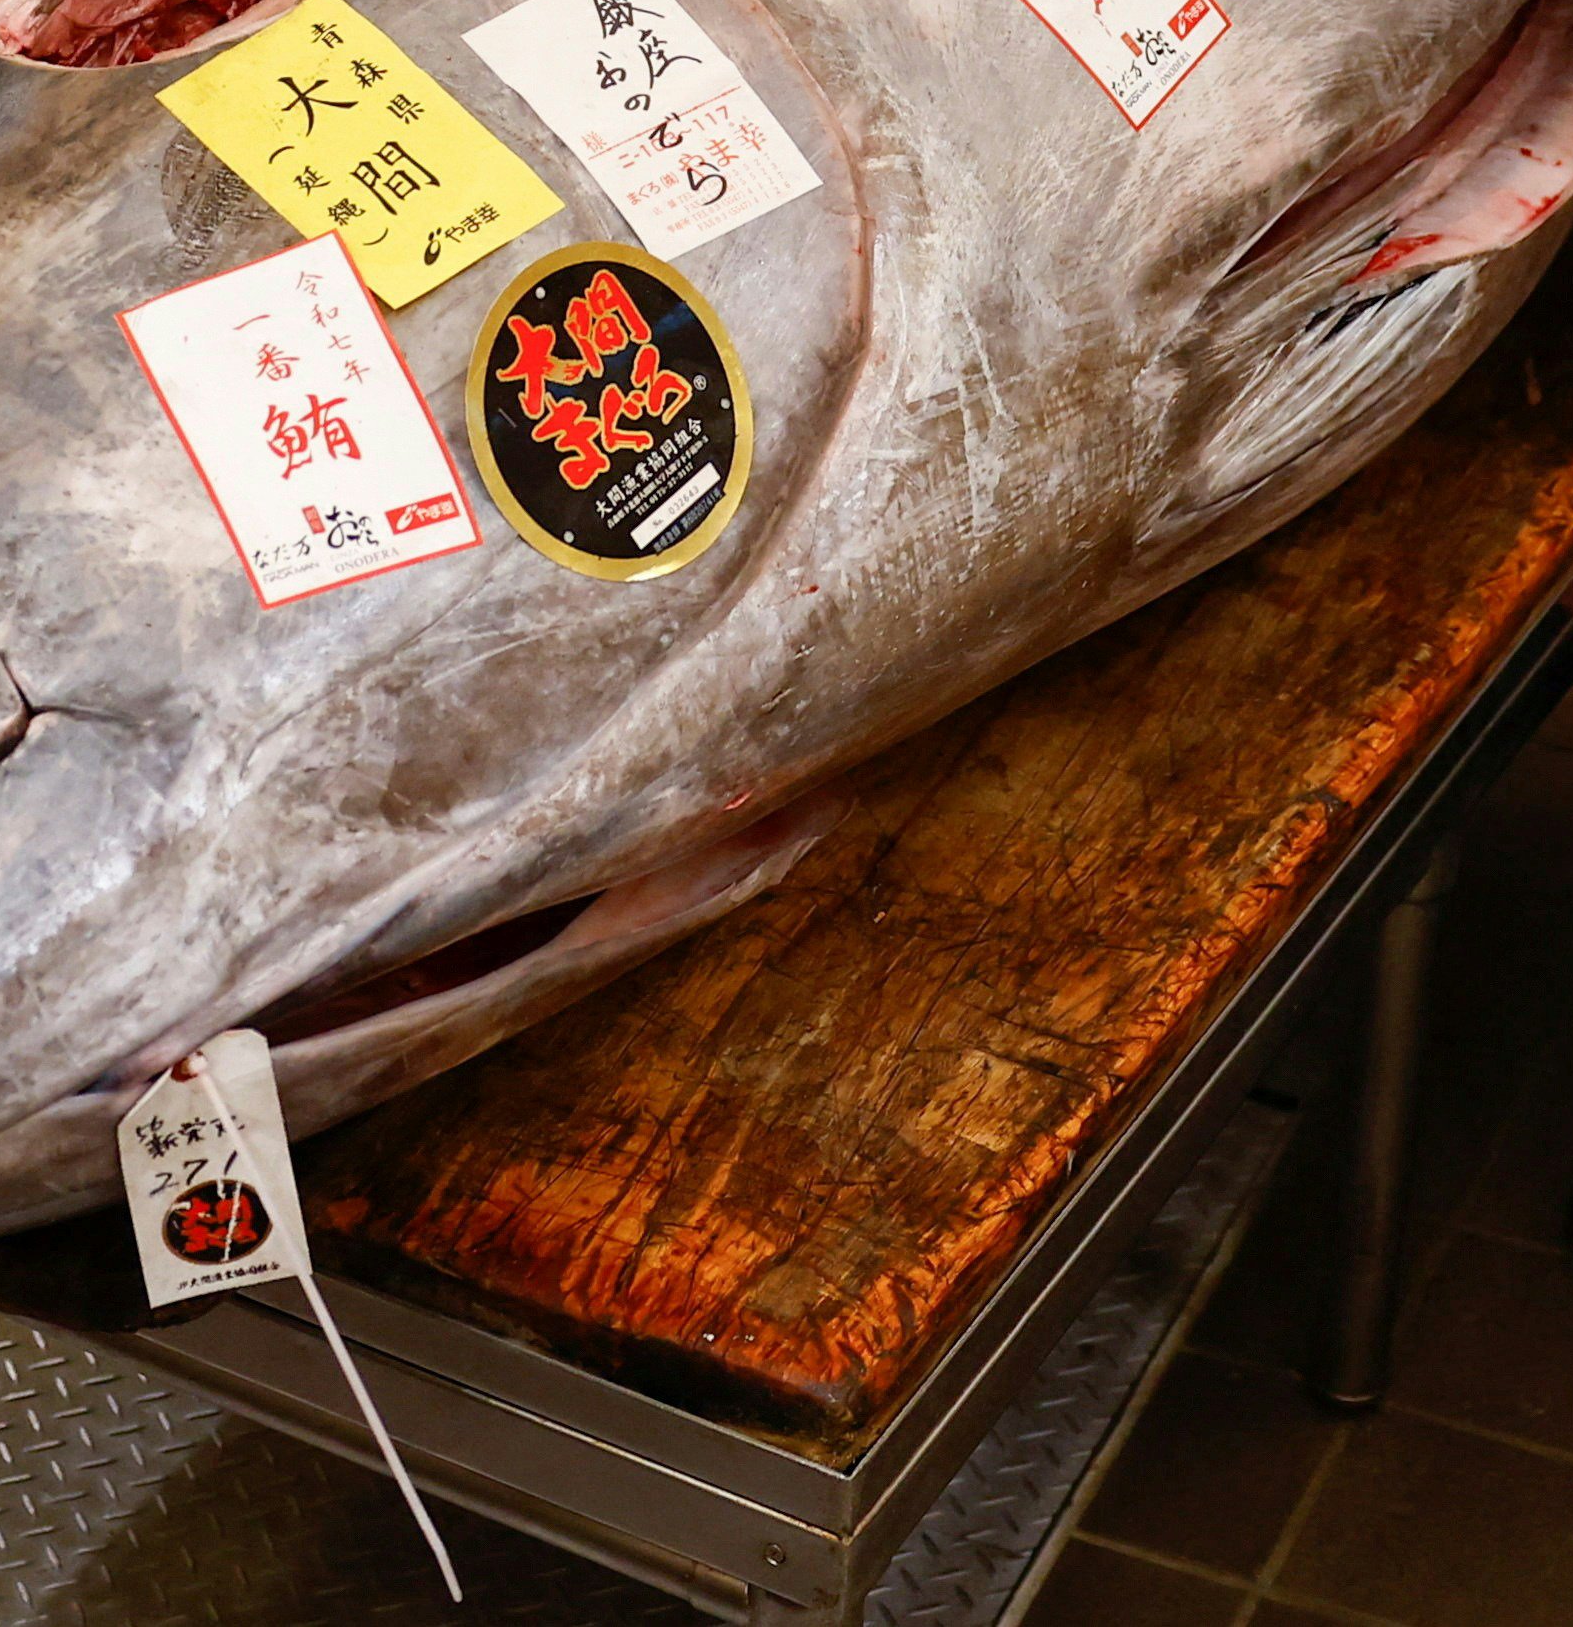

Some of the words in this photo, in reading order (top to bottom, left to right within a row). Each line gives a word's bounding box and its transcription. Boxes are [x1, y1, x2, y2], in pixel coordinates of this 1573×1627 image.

[310, 23, 425, 125] 青森県
[596, 52, 727, 206] おのでら
[277, 75, 441, 216] 大間
[232, 313, 362, 481] 一番鮪
[294, 270, 371, 384] 令和七年
[496, 268, 652, 420] 大間
[531, 342, 693, 490] まぐろ
[595, 418, 702, 519] 大間漁業協同組合
[334, 546, 400, 574] ONODERA
